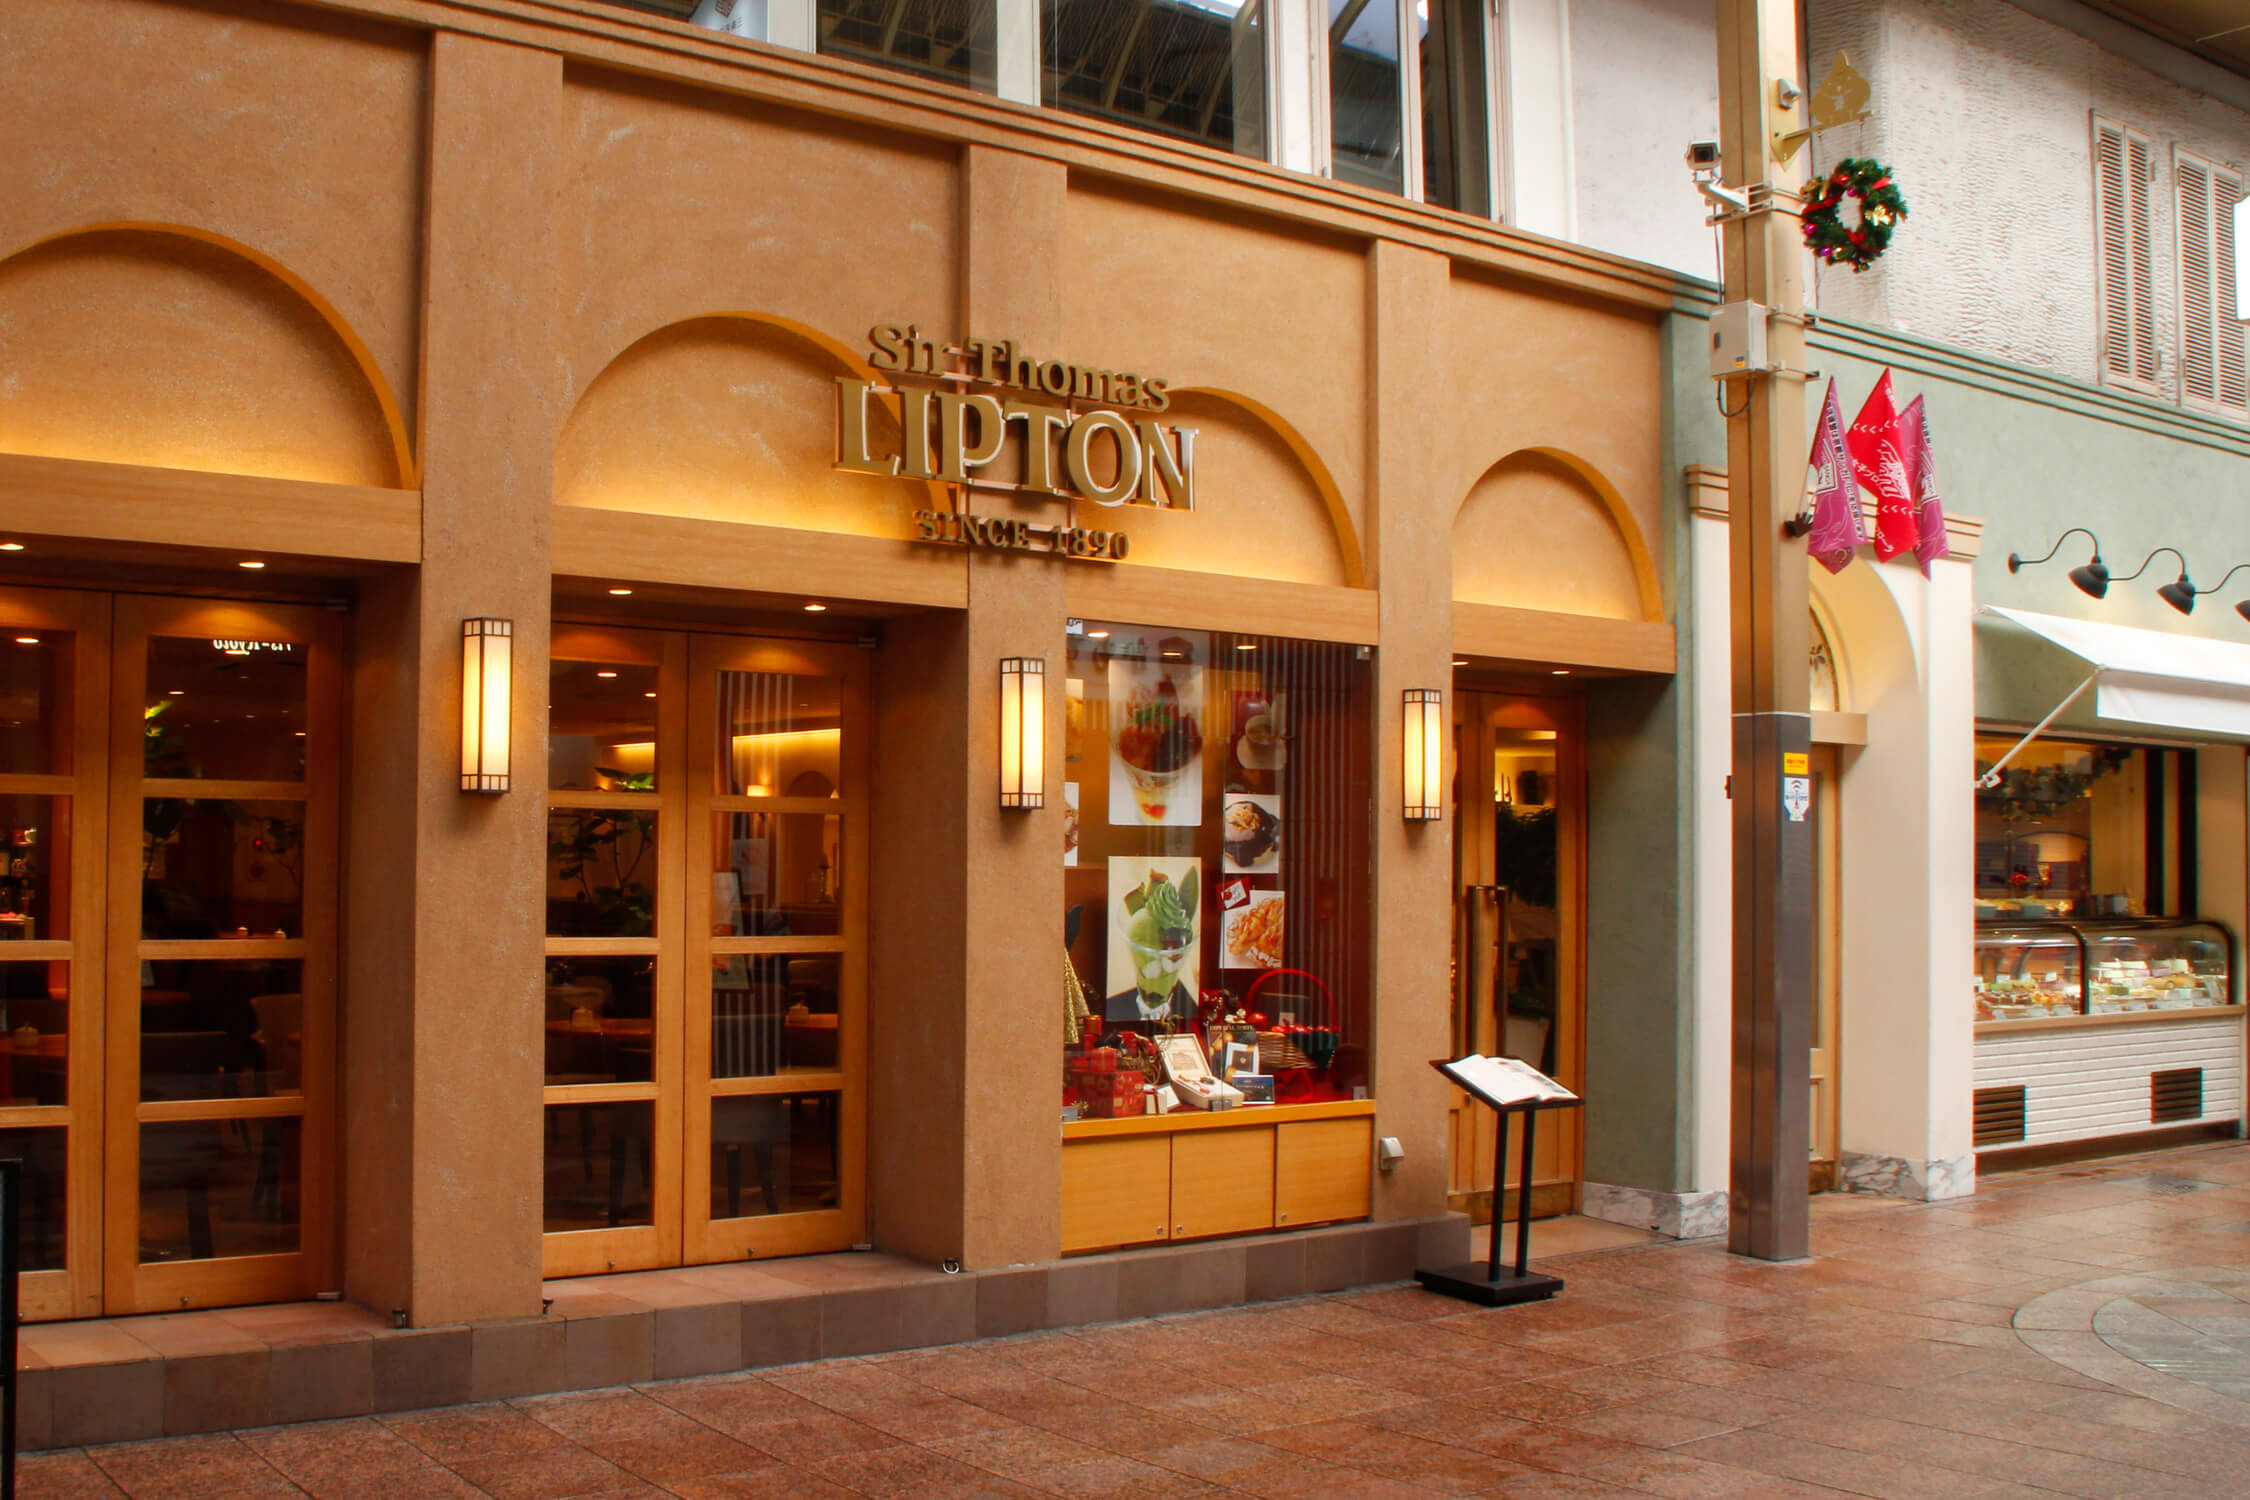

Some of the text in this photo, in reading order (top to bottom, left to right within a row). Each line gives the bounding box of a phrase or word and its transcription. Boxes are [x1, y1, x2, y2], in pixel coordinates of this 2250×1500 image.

[869, 323, 1170, 412] Sir Thomas
[833, 376, 1199, 512] LIPTON
[915, 509, 1129, 559] SINCE 1890
